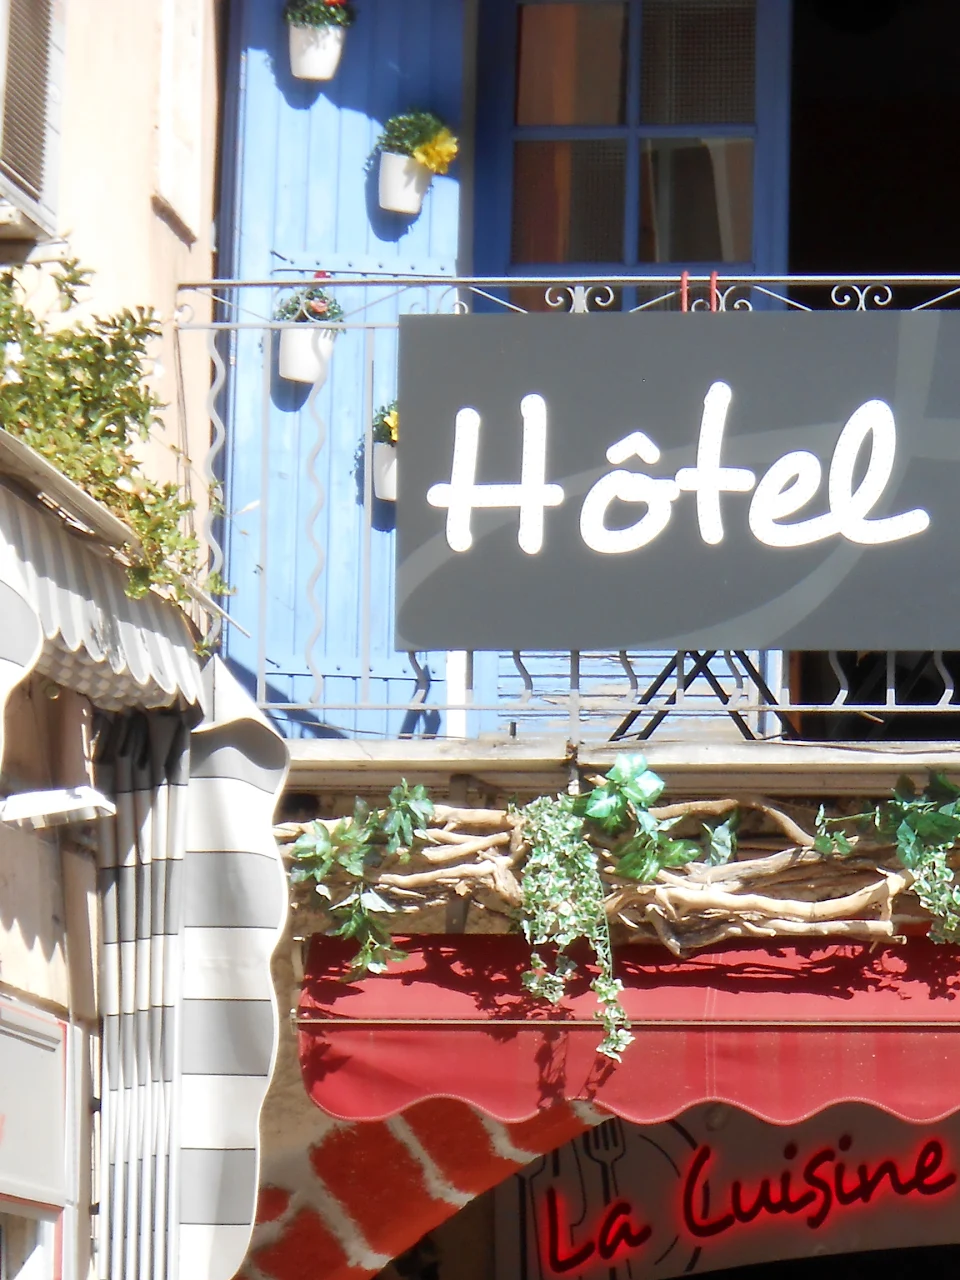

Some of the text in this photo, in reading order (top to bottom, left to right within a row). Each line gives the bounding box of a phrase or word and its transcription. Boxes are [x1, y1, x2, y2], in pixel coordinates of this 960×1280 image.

[425, 380, 930, 556] Hôtel
[546, 1187, 652, 1273] La
[682, 1133, 958, 1238] Cuisine
